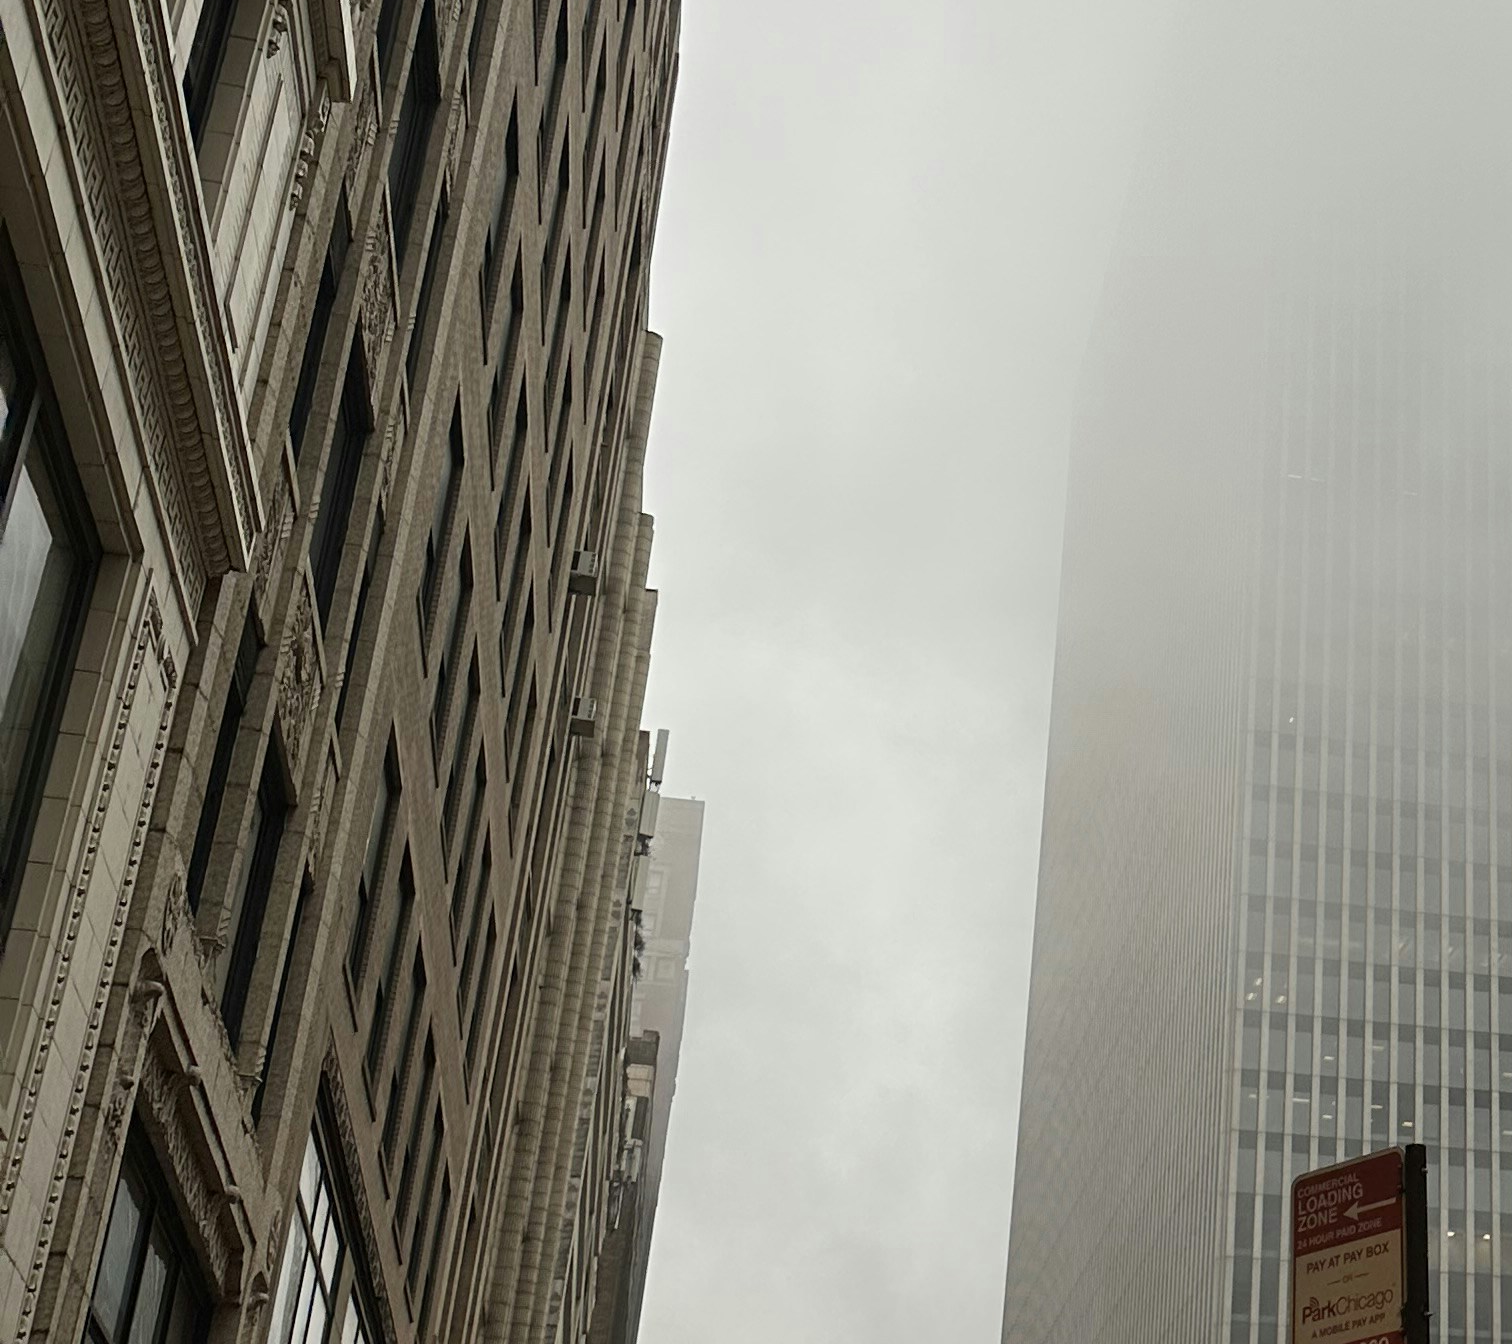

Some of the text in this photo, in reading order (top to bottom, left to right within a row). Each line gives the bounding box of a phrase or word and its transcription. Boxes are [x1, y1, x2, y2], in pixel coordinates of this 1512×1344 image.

[1297, 1173, 1359, 1199] COMMERCIAL
[1298, 1183, 1363, 1216] LOADING
[1297, 1208, 1338, 1233] ZONE
[1309, 1230, 1335, 1247] HOUR
[1336, 1224, 1356, 1238] PAID
[1357, 1217, 1382, 1233] ZONE
[1307, 1242, 1390, 1275] PAY AT PAY BOX
[1302, 1288, 1394, 1325] ParkChicago
[1311, 1312, 1386, 1340] A MOBILE PAY APP
